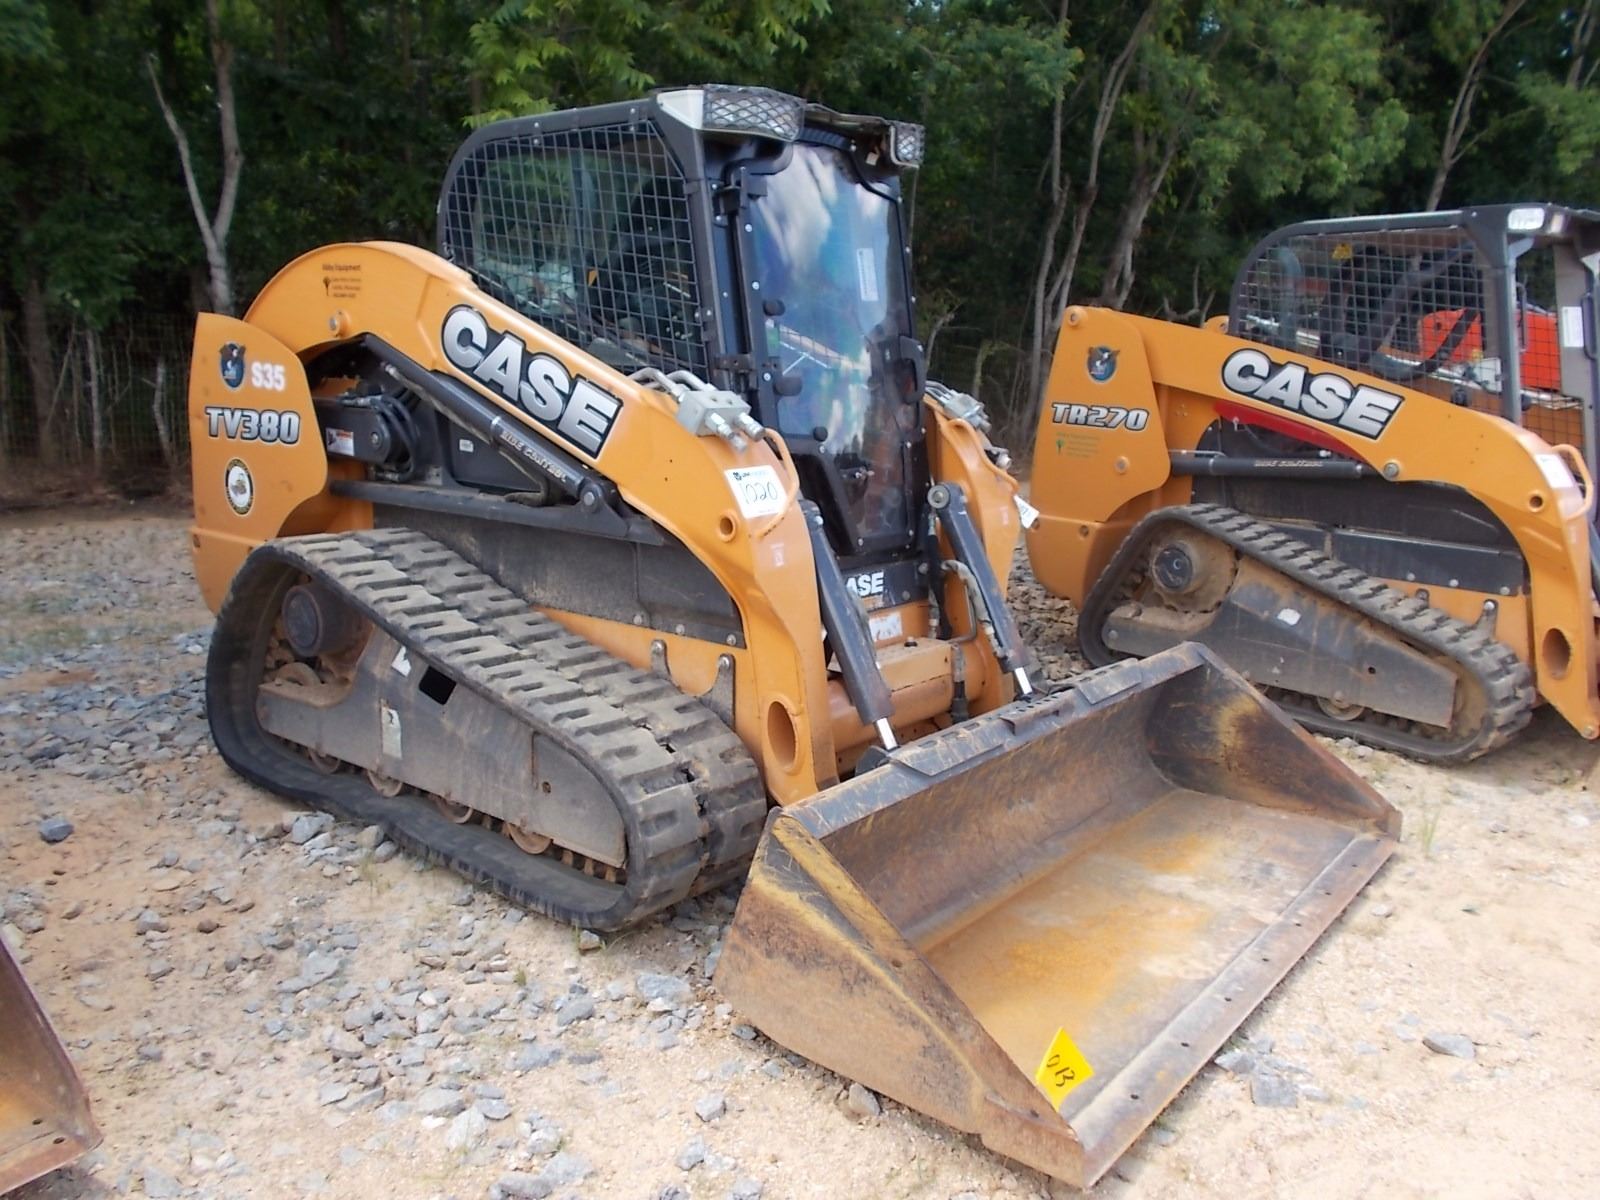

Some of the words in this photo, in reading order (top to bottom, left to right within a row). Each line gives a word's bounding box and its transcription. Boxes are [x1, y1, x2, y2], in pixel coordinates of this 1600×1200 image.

[251, 361, 285, 391] S35
[442, 305, 622, 457] CASE
[1222, 349, 1404, 439] CASE
[205, 406, 301, 445] TV380
[1052, 403, 1149, 431] TR270
[740, 481, 778, 505] 1020
[846, 571, 885, 597] ASE
